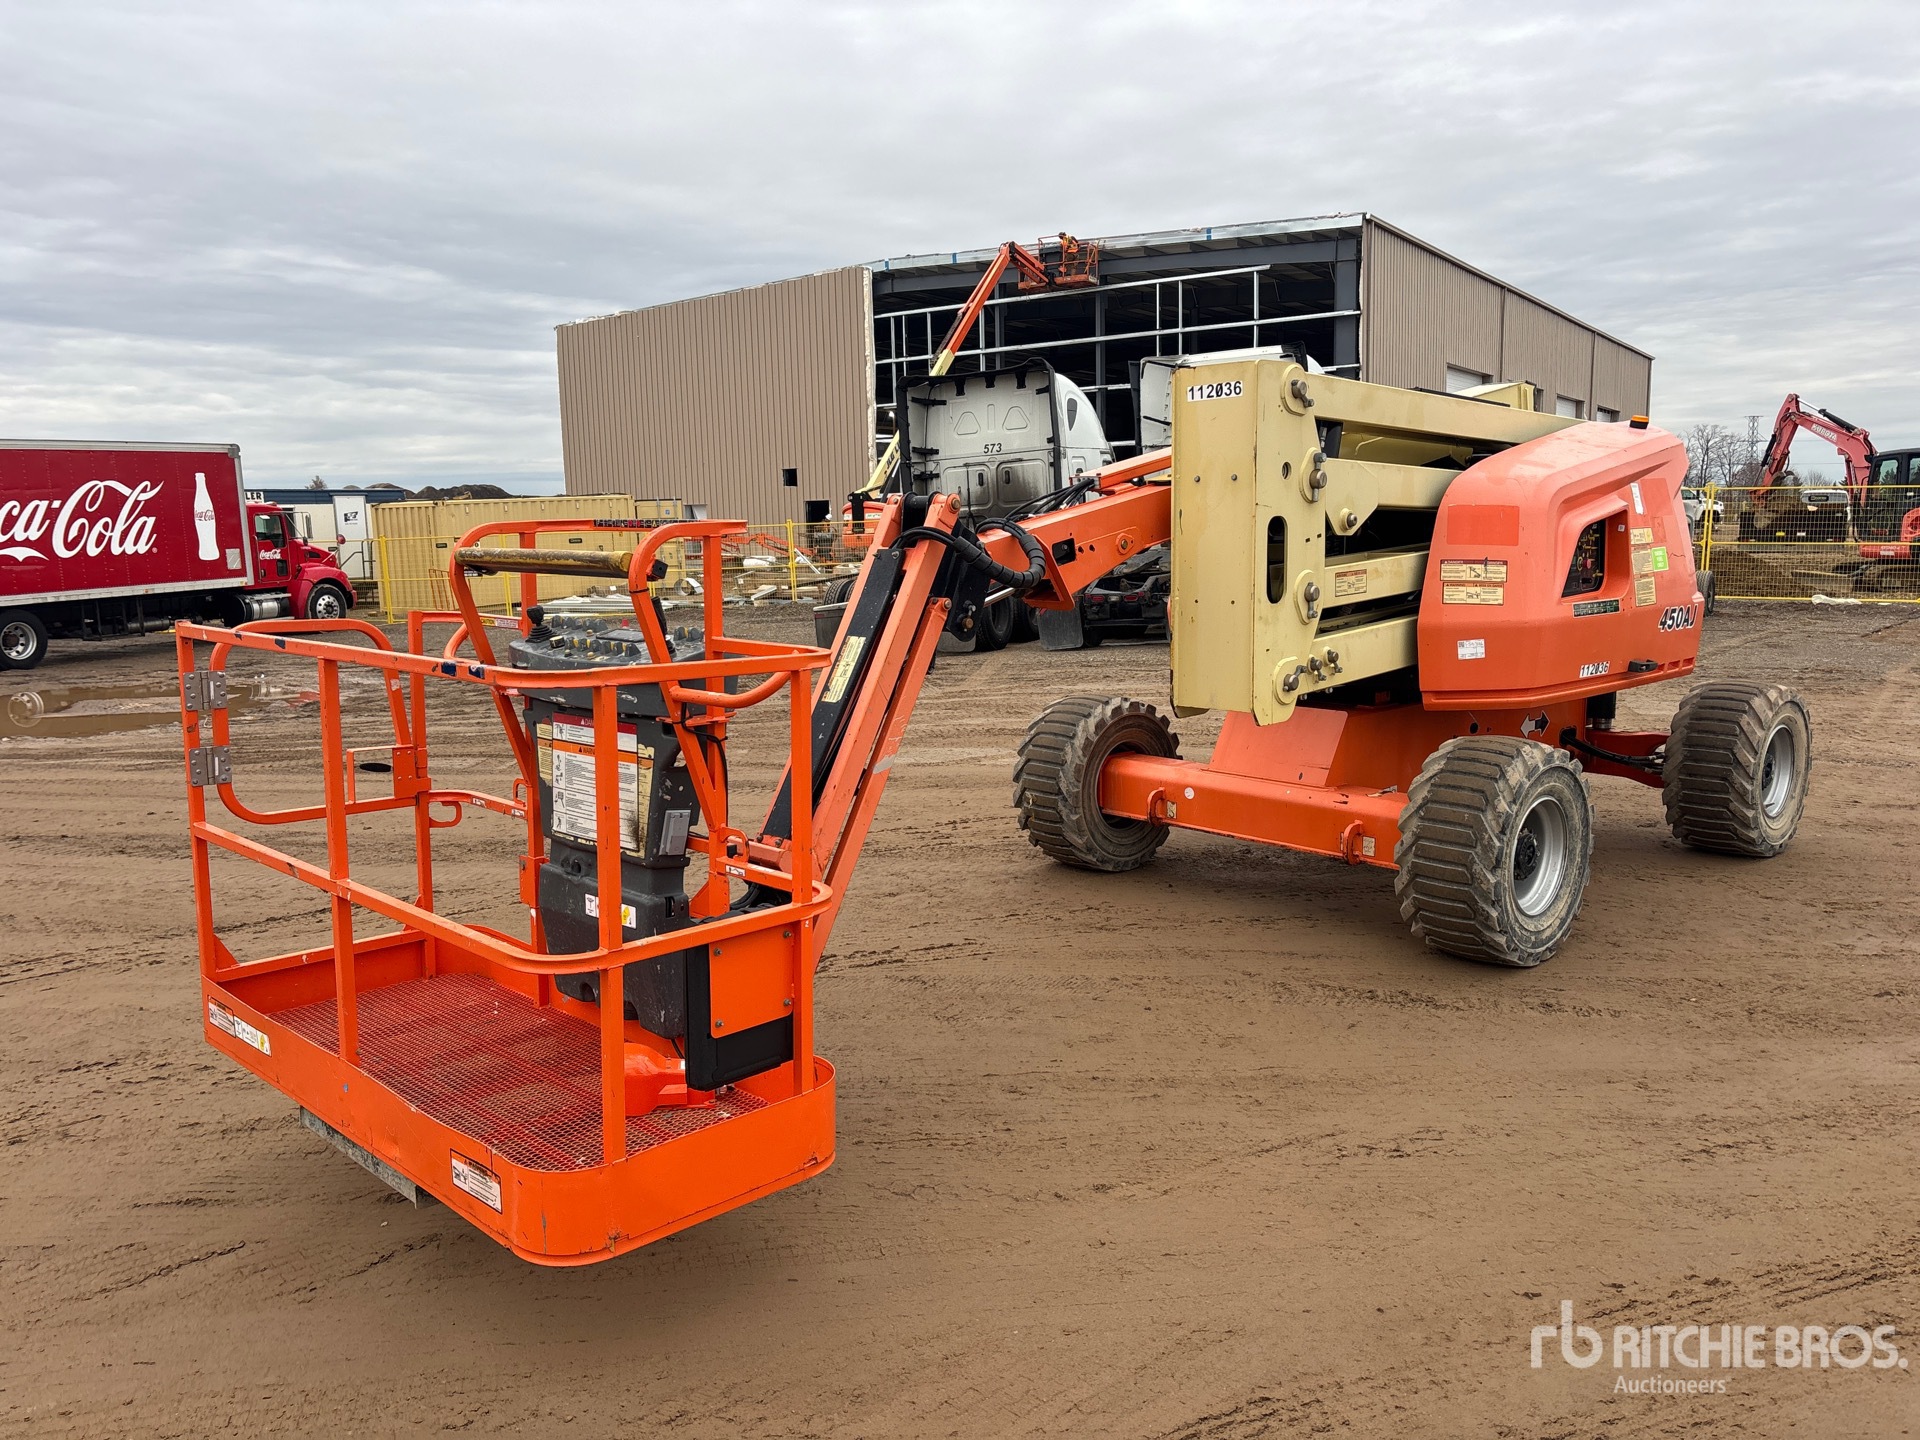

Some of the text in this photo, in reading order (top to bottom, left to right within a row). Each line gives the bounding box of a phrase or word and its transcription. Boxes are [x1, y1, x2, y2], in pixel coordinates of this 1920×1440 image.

[1188, 380, 1242, 400] 112036
[983, 443, 1003, 454] 573
[1658, 604, 1698, 632] 450AJ
[1581, 661, 1609, 677] 112036
